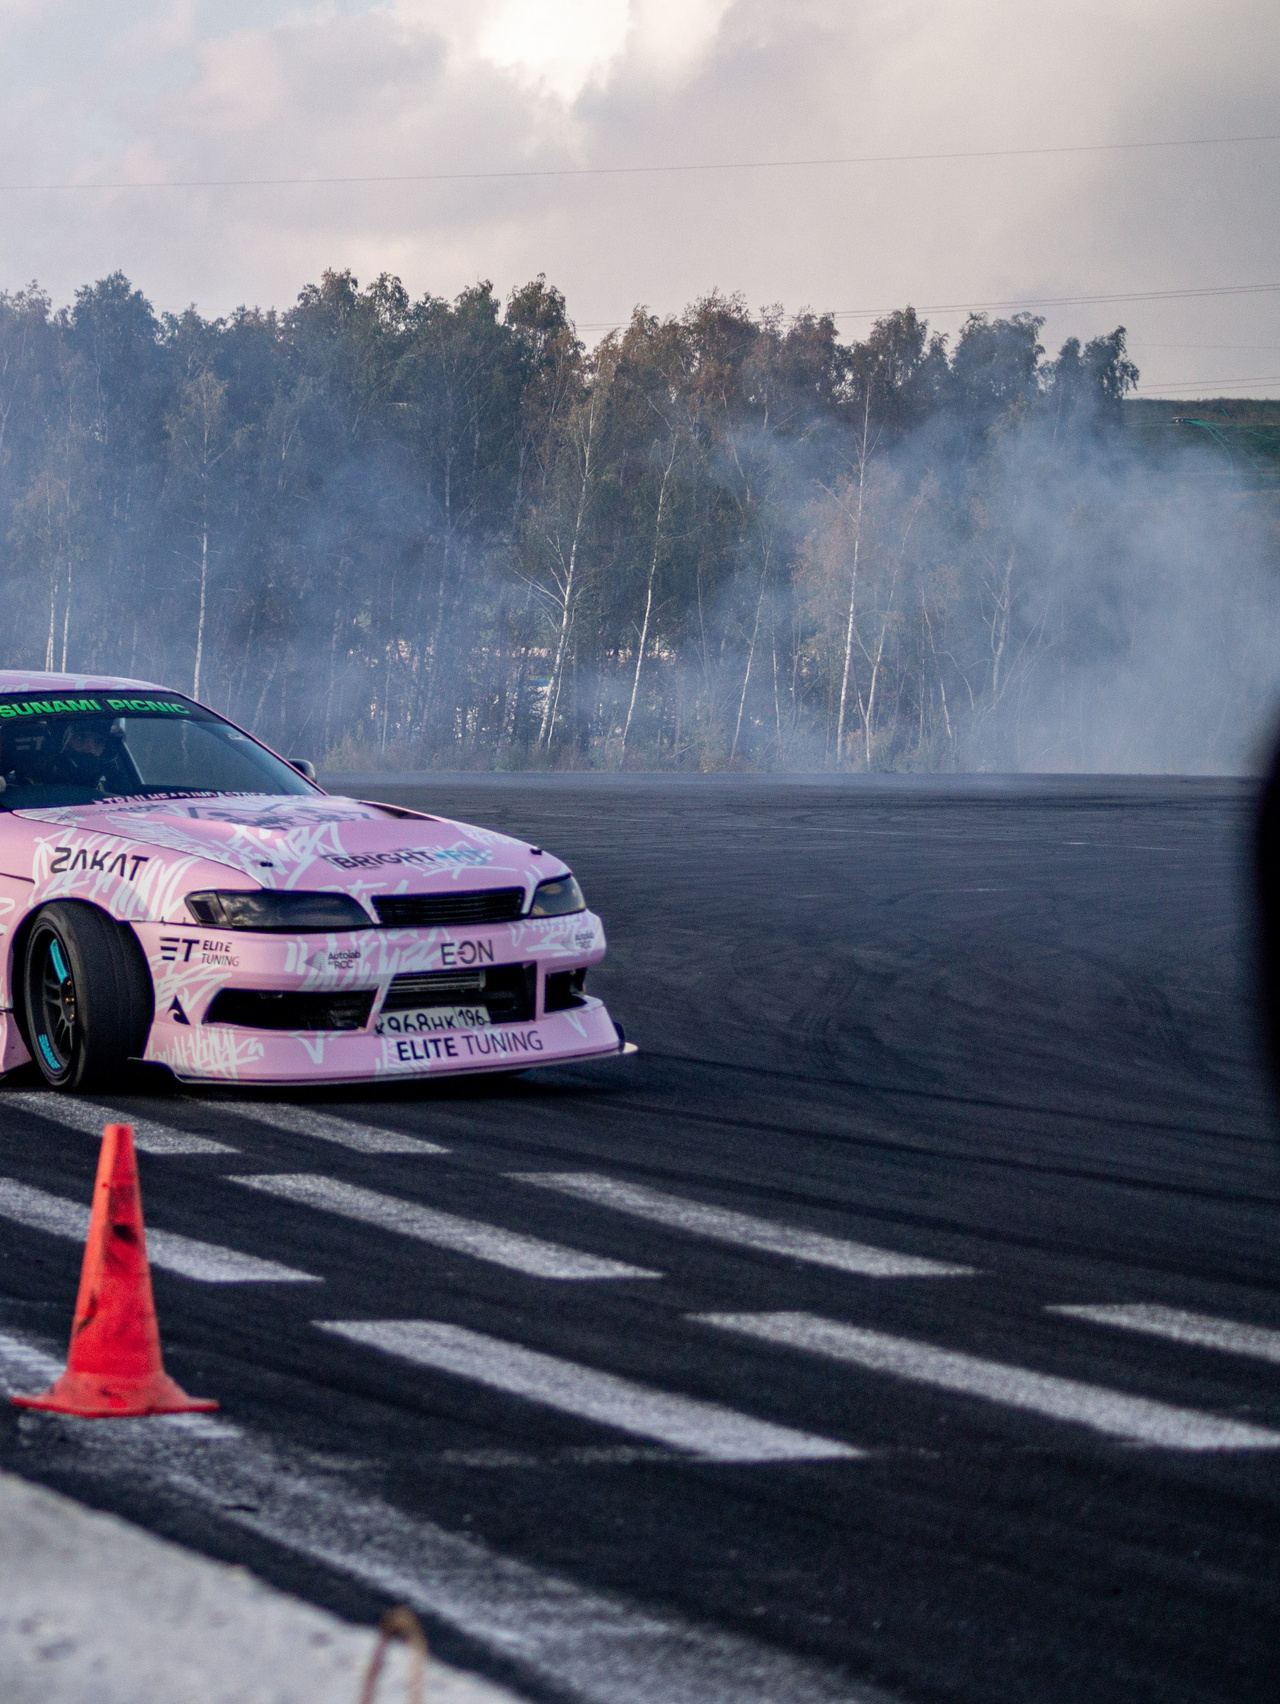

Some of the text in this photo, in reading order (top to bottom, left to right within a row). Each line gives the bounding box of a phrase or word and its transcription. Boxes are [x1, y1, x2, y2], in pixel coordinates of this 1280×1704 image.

[107, 699, 191, 715] PICNIC
[202, 940, 232, 953] ELITE
[201, 952, 240, 967] TUNING
[328, 949, 361, 960] Autolab
[396, 1030, 544, 1062] ELITE TUNING
